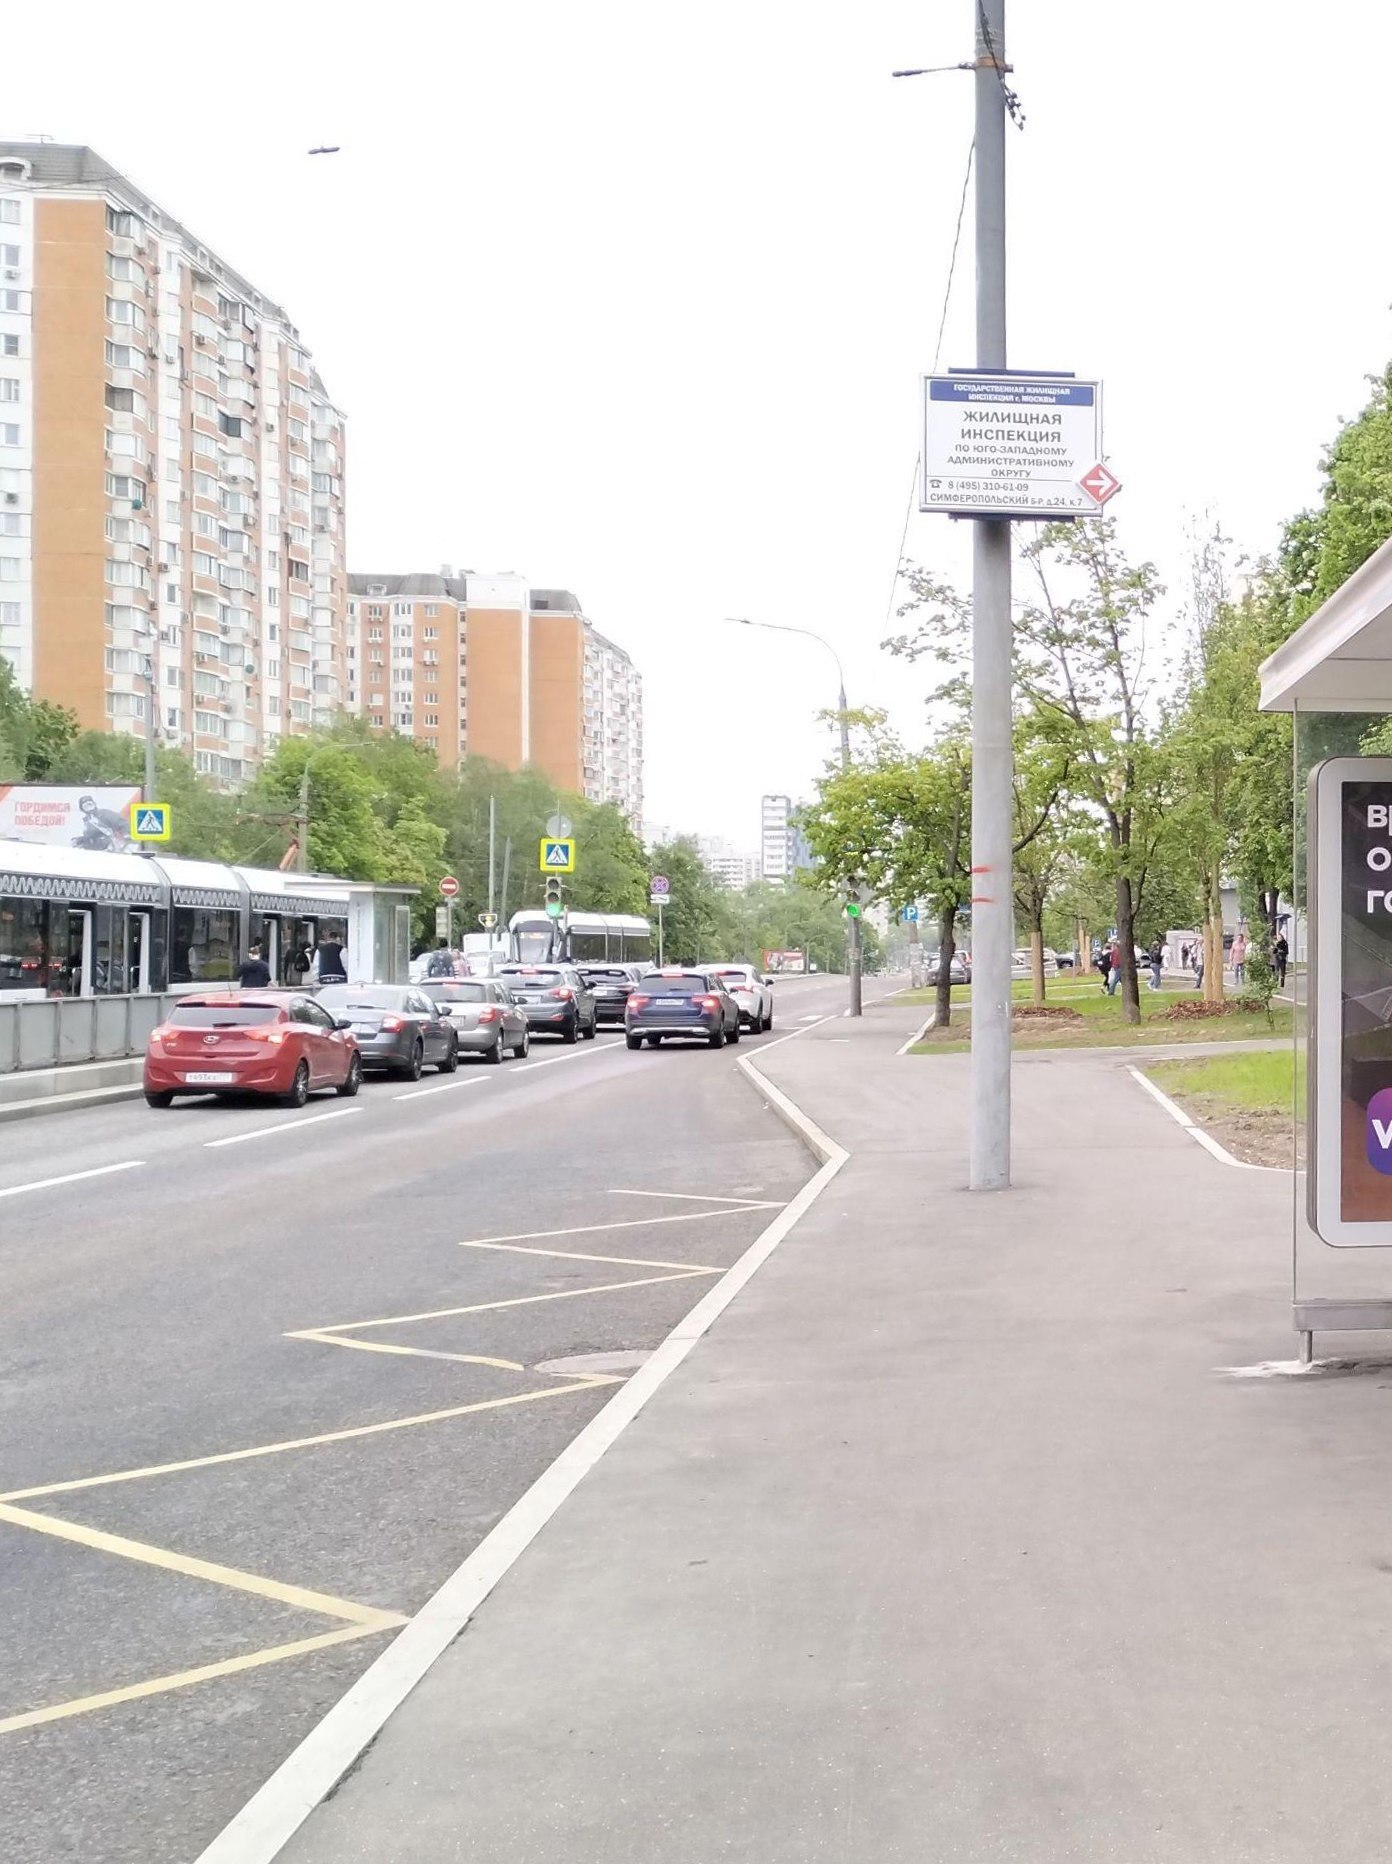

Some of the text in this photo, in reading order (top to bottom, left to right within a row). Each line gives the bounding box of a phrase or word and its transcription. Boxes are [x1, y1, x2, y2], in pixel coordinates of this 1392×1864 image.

[963, 410, 1063, 426] ЖИЛИЩНАЯ
[961, 428, 1062, 443] ИНСПЕКЦИЯ
[954, 443, 1068, 456] ПО ЮГО-ЗАПАДНОМУ
[946, 455, 1075, 468] АДМИНИСТРАТИВНОМУ
[990, 468, 1032, 478] ОКРУГУ
[947, 481, 1029, 492] 8 (495) 310-61-09
[930, 493, 1029, 505] СИМФЕРОПОЛЬСКИЙ
